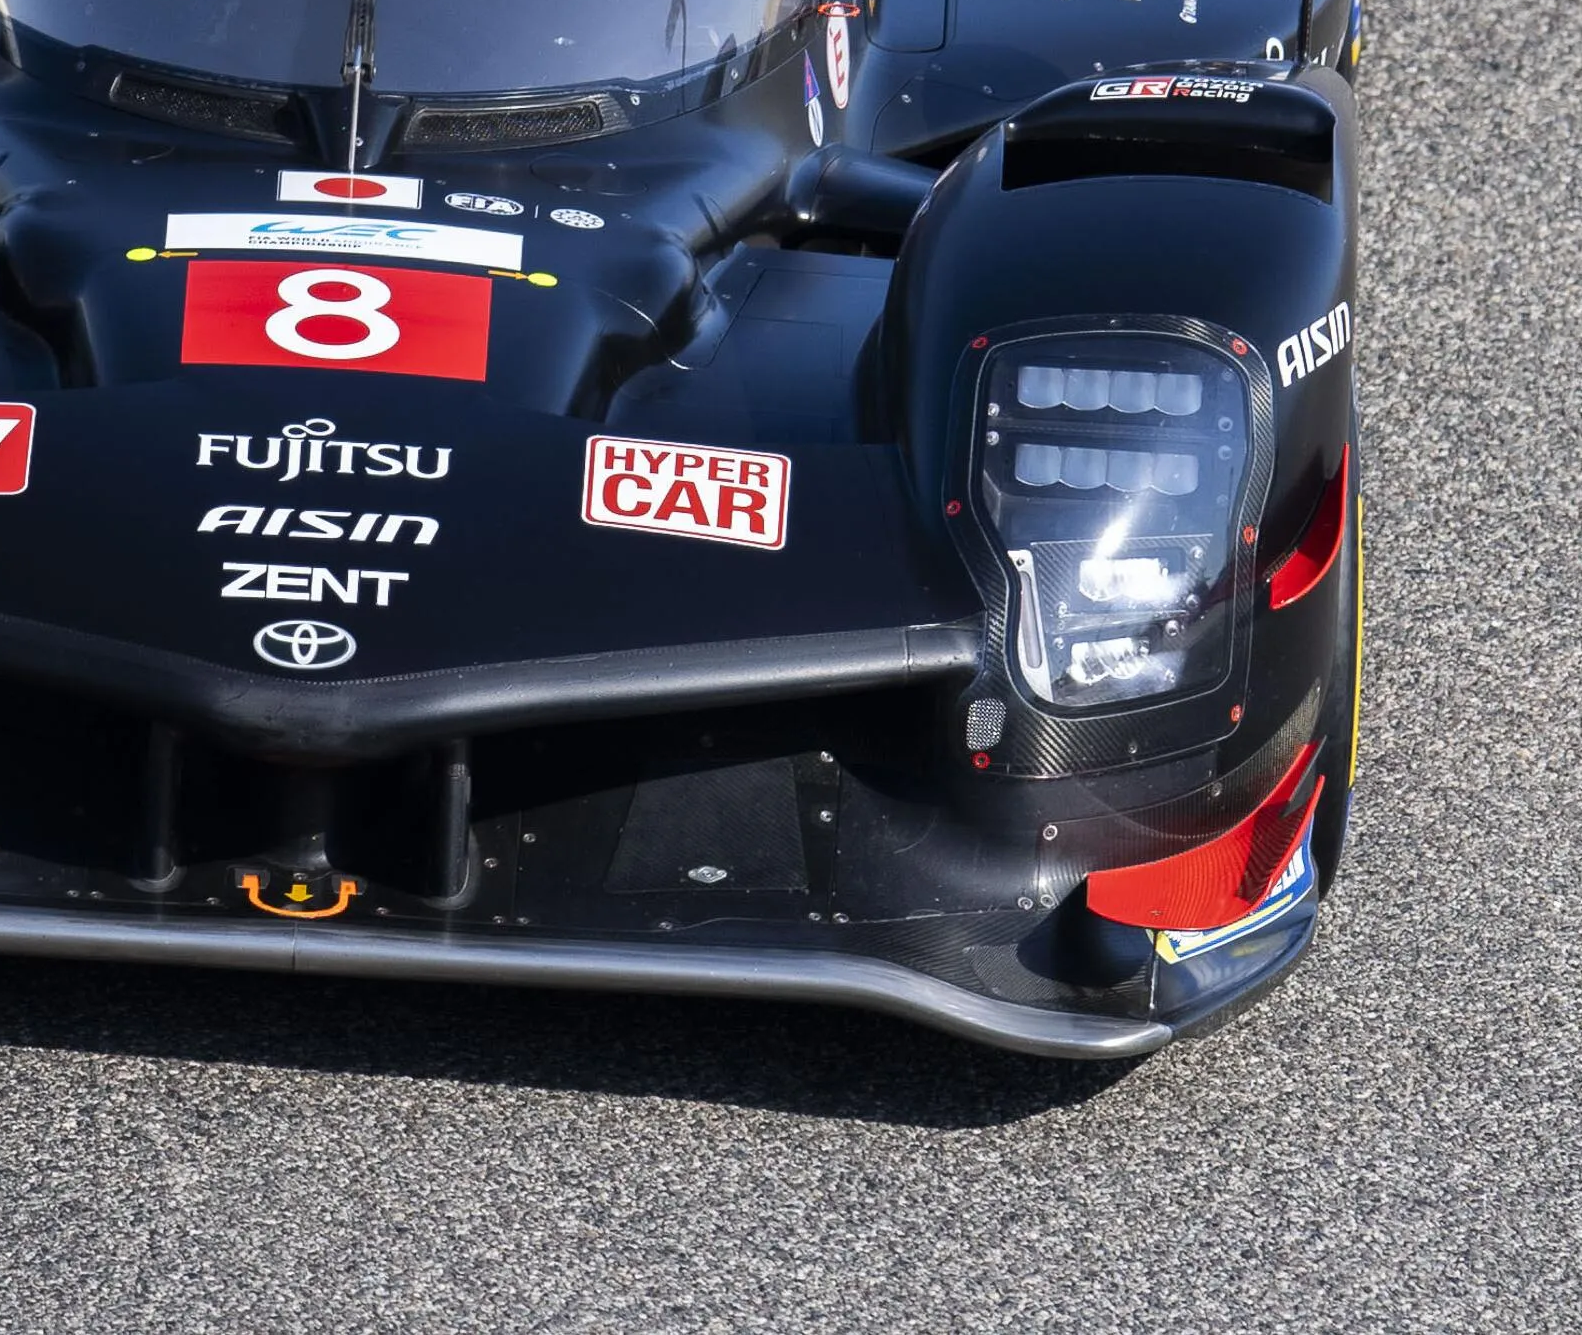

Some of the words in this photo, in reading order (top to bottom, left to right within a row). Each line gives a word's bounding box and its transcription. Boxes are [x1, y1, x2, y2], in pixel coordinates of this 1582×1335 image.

[1095, 81, 1169, 96] GR
[1172, 88, 1250, 103] Racing
[451, 194, 519, 214] FIA
[250, 221, 437, 241] WEC
[265, 268, 400, 360] 8
[1277, 301, 1351, 388] AISIN
[196, 419, 453, 482] FUJITSU
[604, 446, 771, 489] HYPER
[196, 505, 440, 546] AISIN
[601, 474, 770, 539] CAR
[221, 562, 410, 606] ZENT
